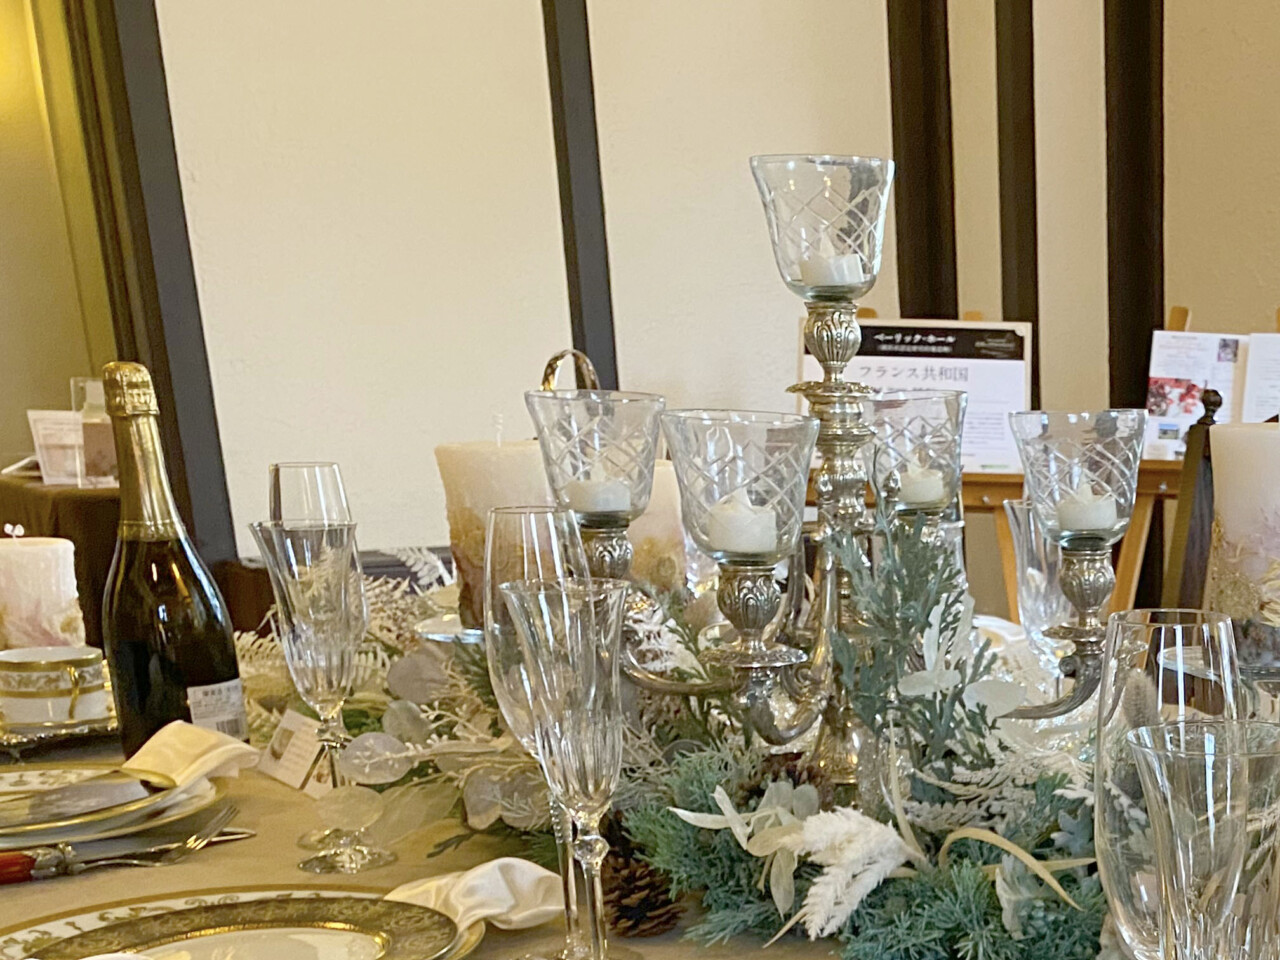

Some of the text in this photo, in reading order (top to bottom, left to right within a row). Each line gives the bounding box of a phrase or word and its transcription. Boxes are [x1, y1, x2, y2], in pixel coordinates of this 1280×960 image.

[859, 366, 968, 382] フランス共和国
